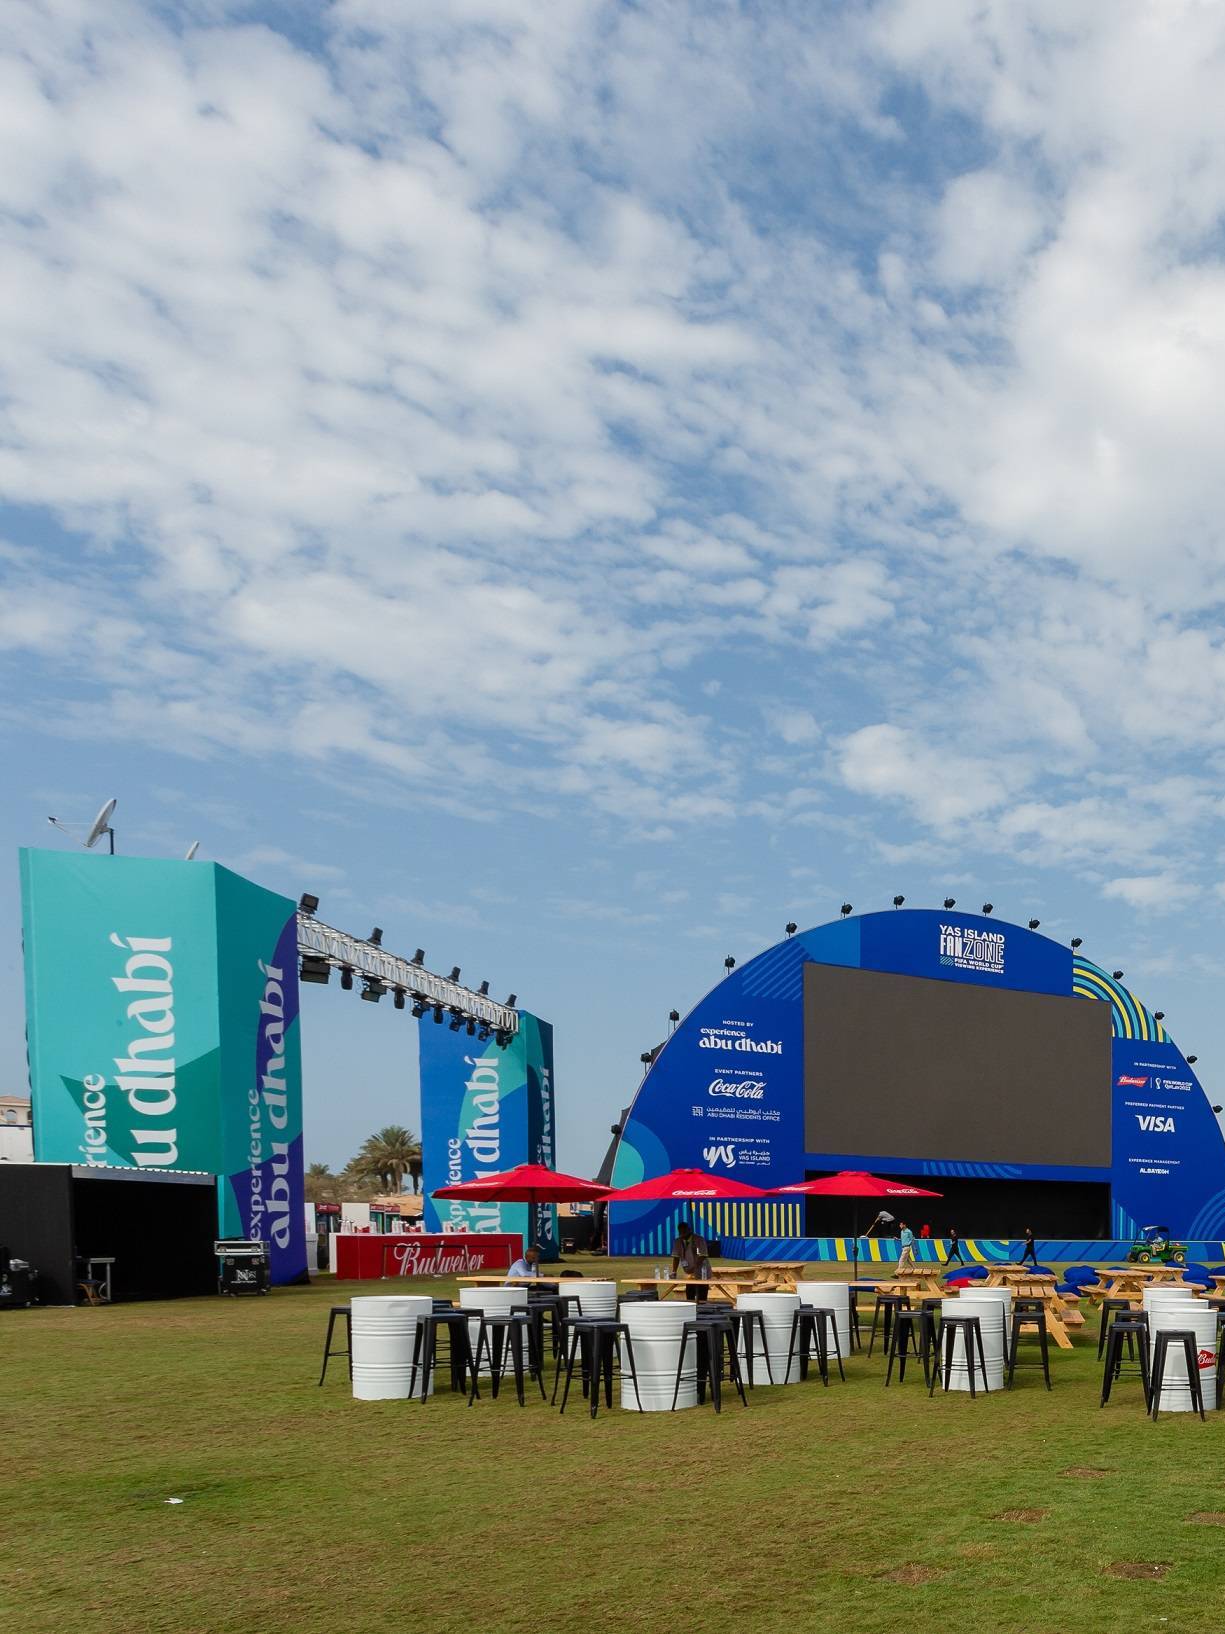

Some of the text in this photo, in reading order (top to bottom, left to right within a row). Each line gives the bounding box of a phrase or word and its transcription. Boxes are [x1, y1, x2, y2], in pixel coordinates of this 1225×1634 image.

[939, 924, 1005, 943] YAS ISLAND
[699, 1035, 733, 1050] abu
[708, 1078, 767, 1099] Coca-Cola
[1135, 1114, 1175, 1132] VISA
[264, 1142, 290, 1249] abu
